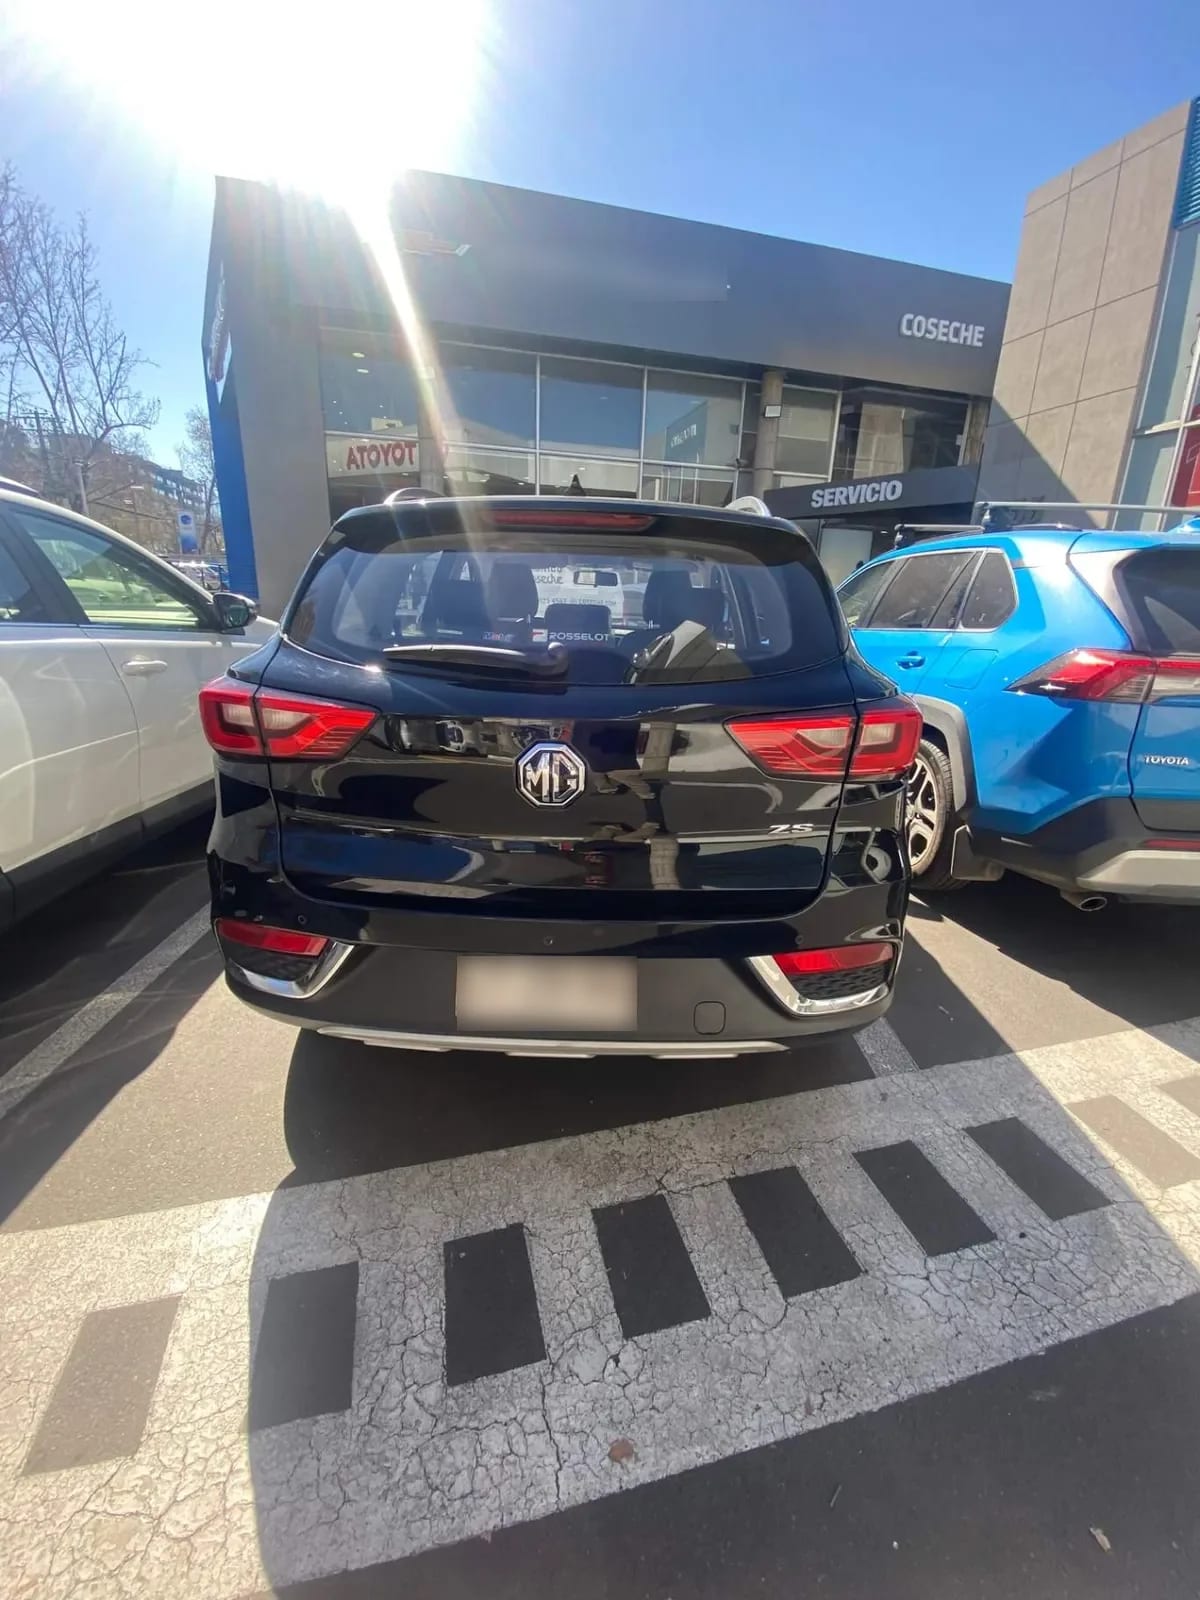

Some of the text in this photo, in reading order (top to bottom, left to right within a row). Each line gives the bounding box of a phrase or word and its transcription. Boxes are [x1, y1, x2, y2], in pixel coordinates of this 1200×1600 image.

[901, 313, 985, 347] COSECHE
[810, 480, 903, 508] SERVICIO
[548, 632, 609, 641] ROSSELOT
[1144, 755, 1189, 765] TOYOTA
[524, 752, 577, 802] MG
[769, 823, 815, 834] ZS
